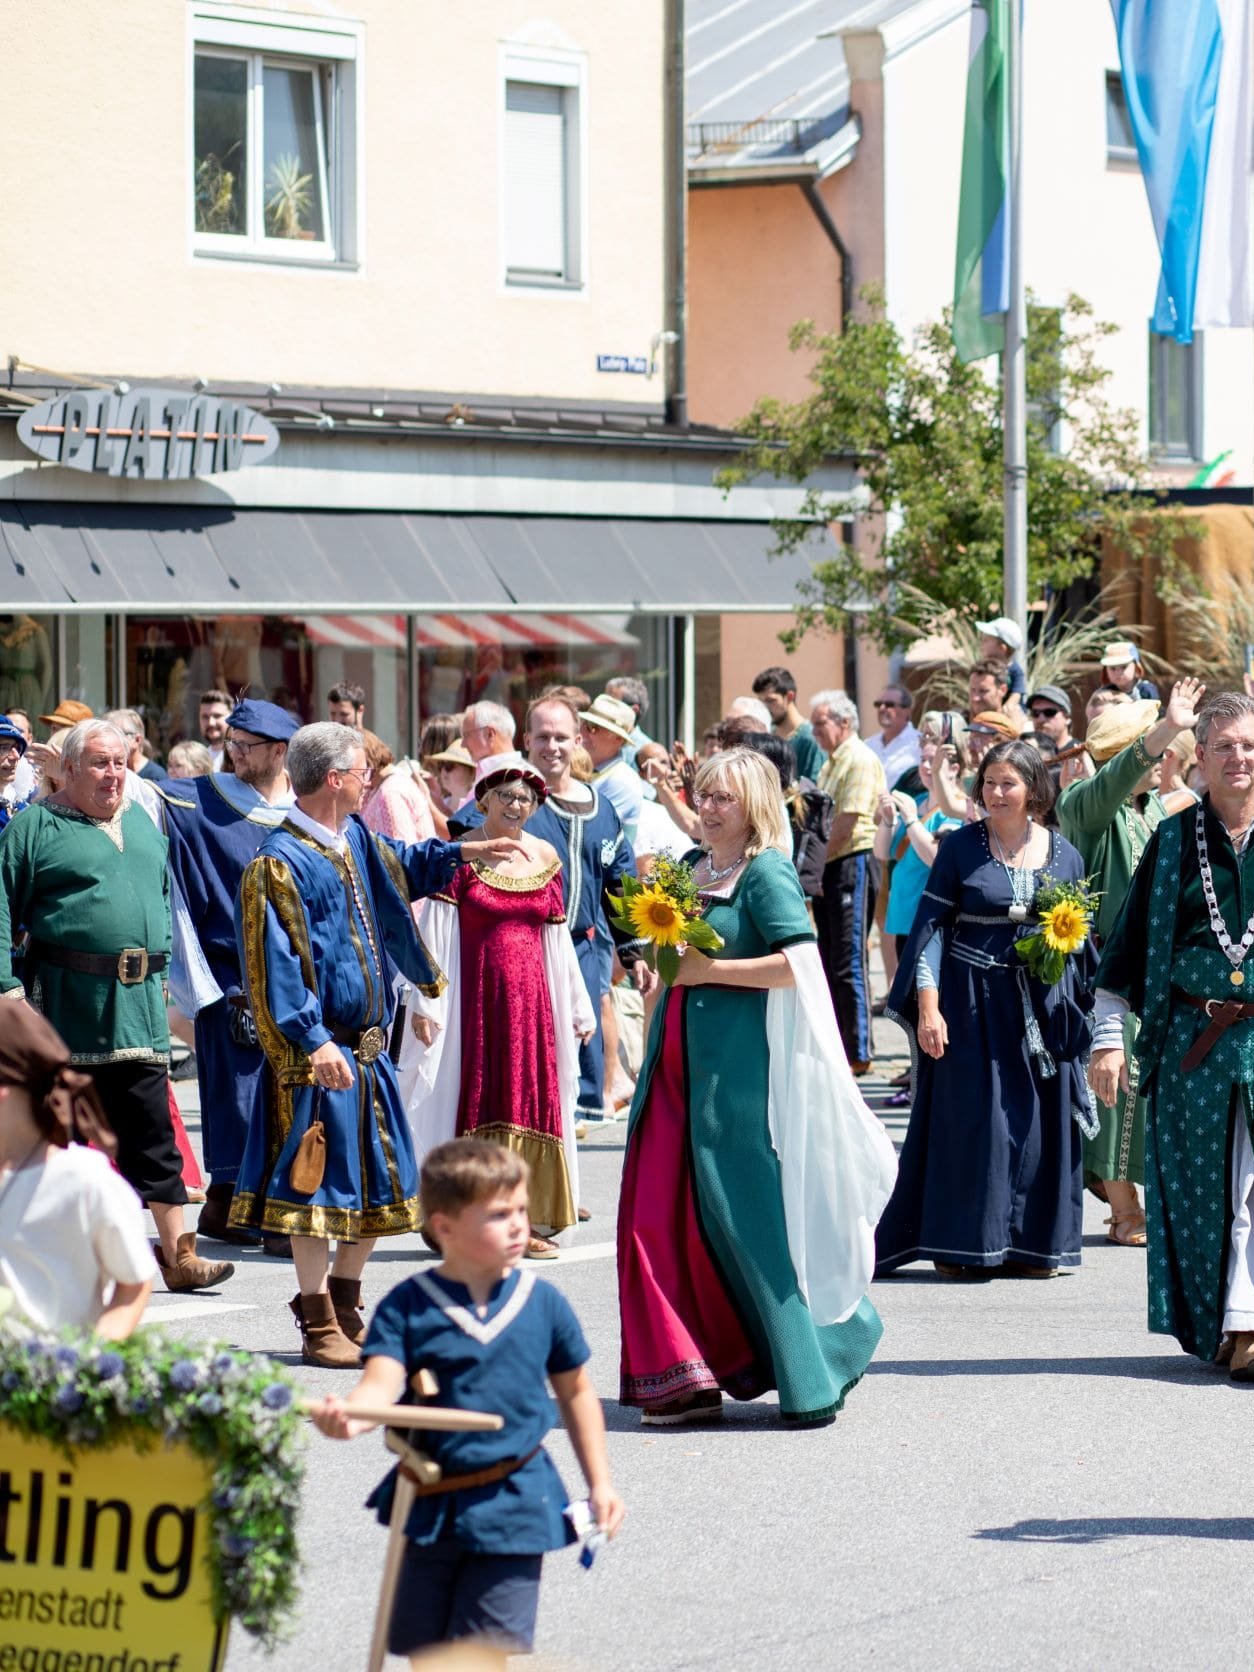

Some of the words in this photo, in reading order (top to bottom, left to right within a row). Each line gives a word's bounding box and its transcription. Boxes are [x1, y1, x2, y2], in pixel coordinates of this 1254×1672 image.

[59, 393, 248, 479] PLATIN
[0, 1470, 196, 1601] tling
[0, 1586, 125, 1632] enstadt
